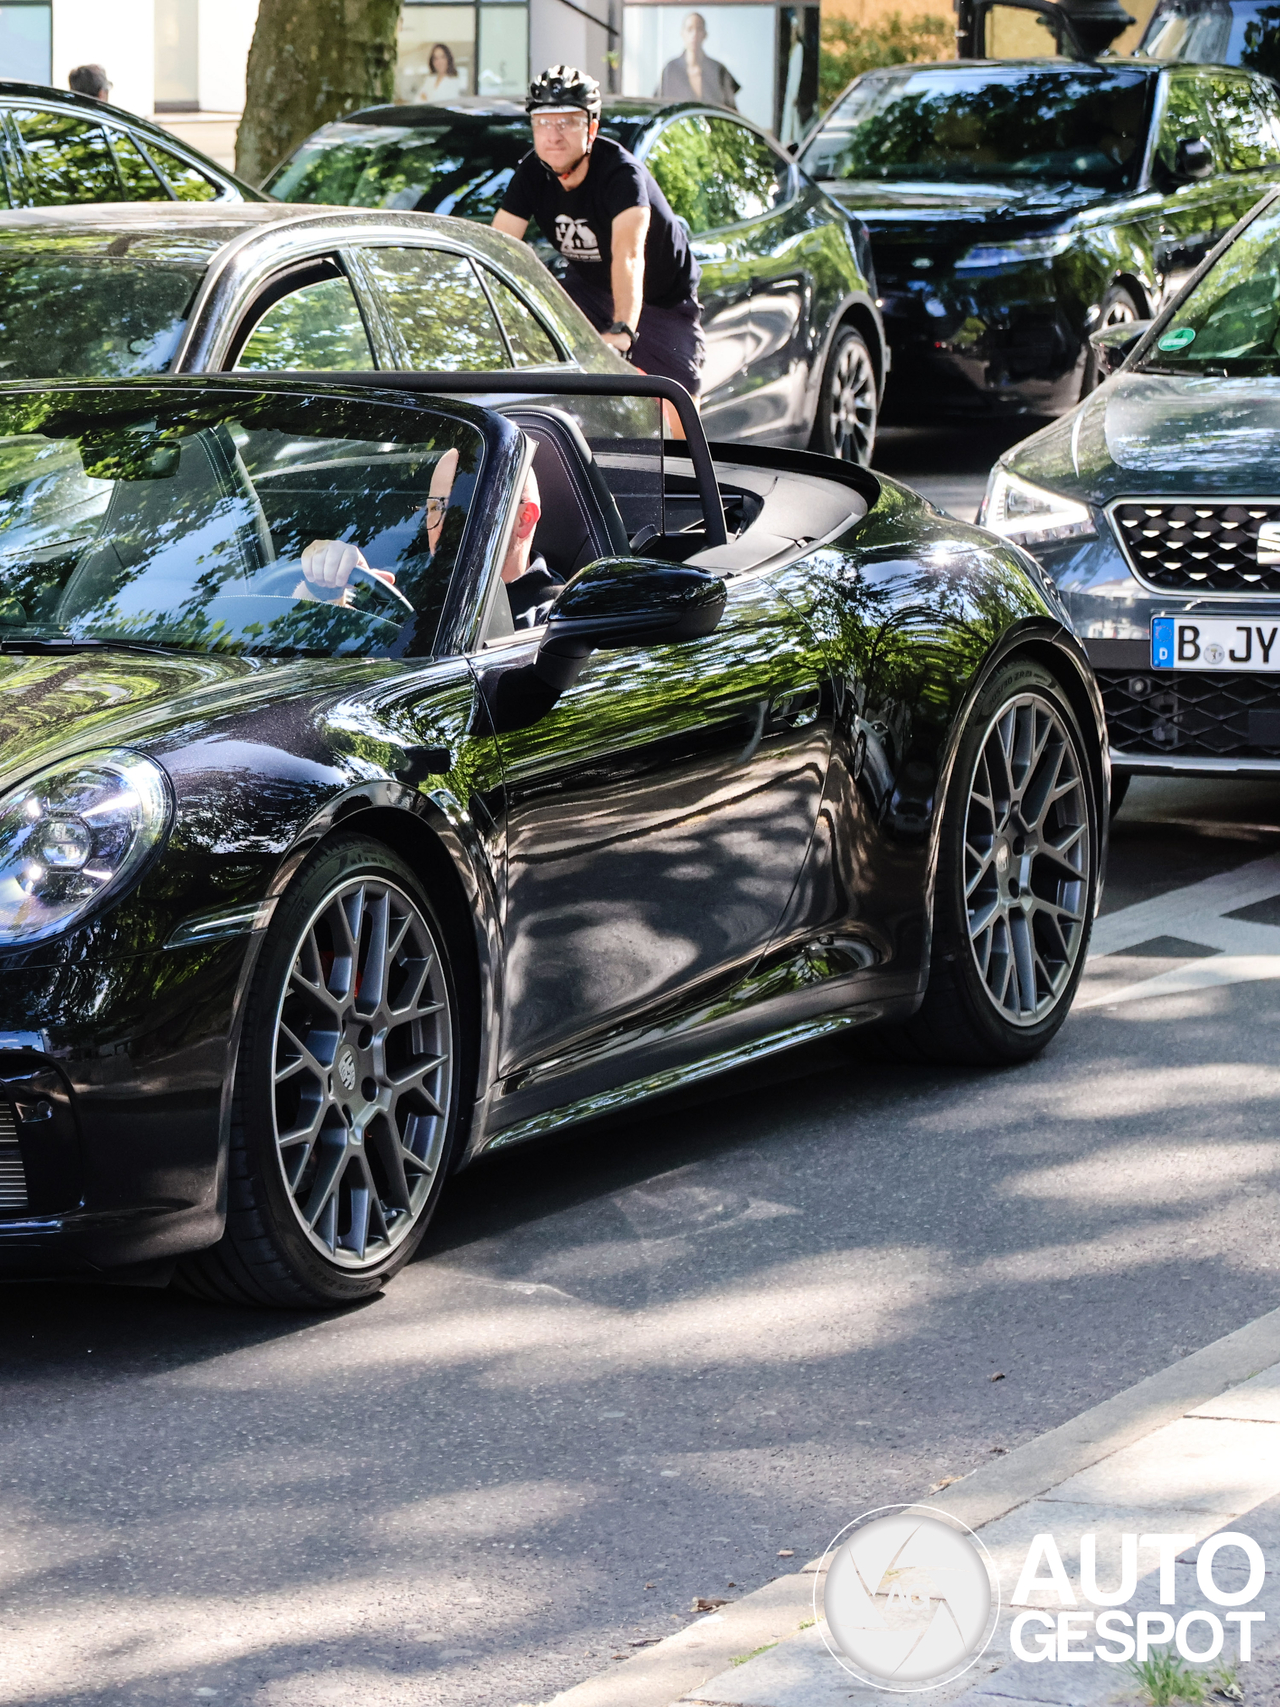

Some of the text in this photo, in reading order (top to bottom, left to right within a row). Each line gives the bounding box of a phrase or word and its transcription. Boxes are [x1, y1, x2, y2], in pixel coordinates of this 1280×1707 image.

[1159, 647, 1168, 660] D
[1178, 625, 1278, 664] B JY
